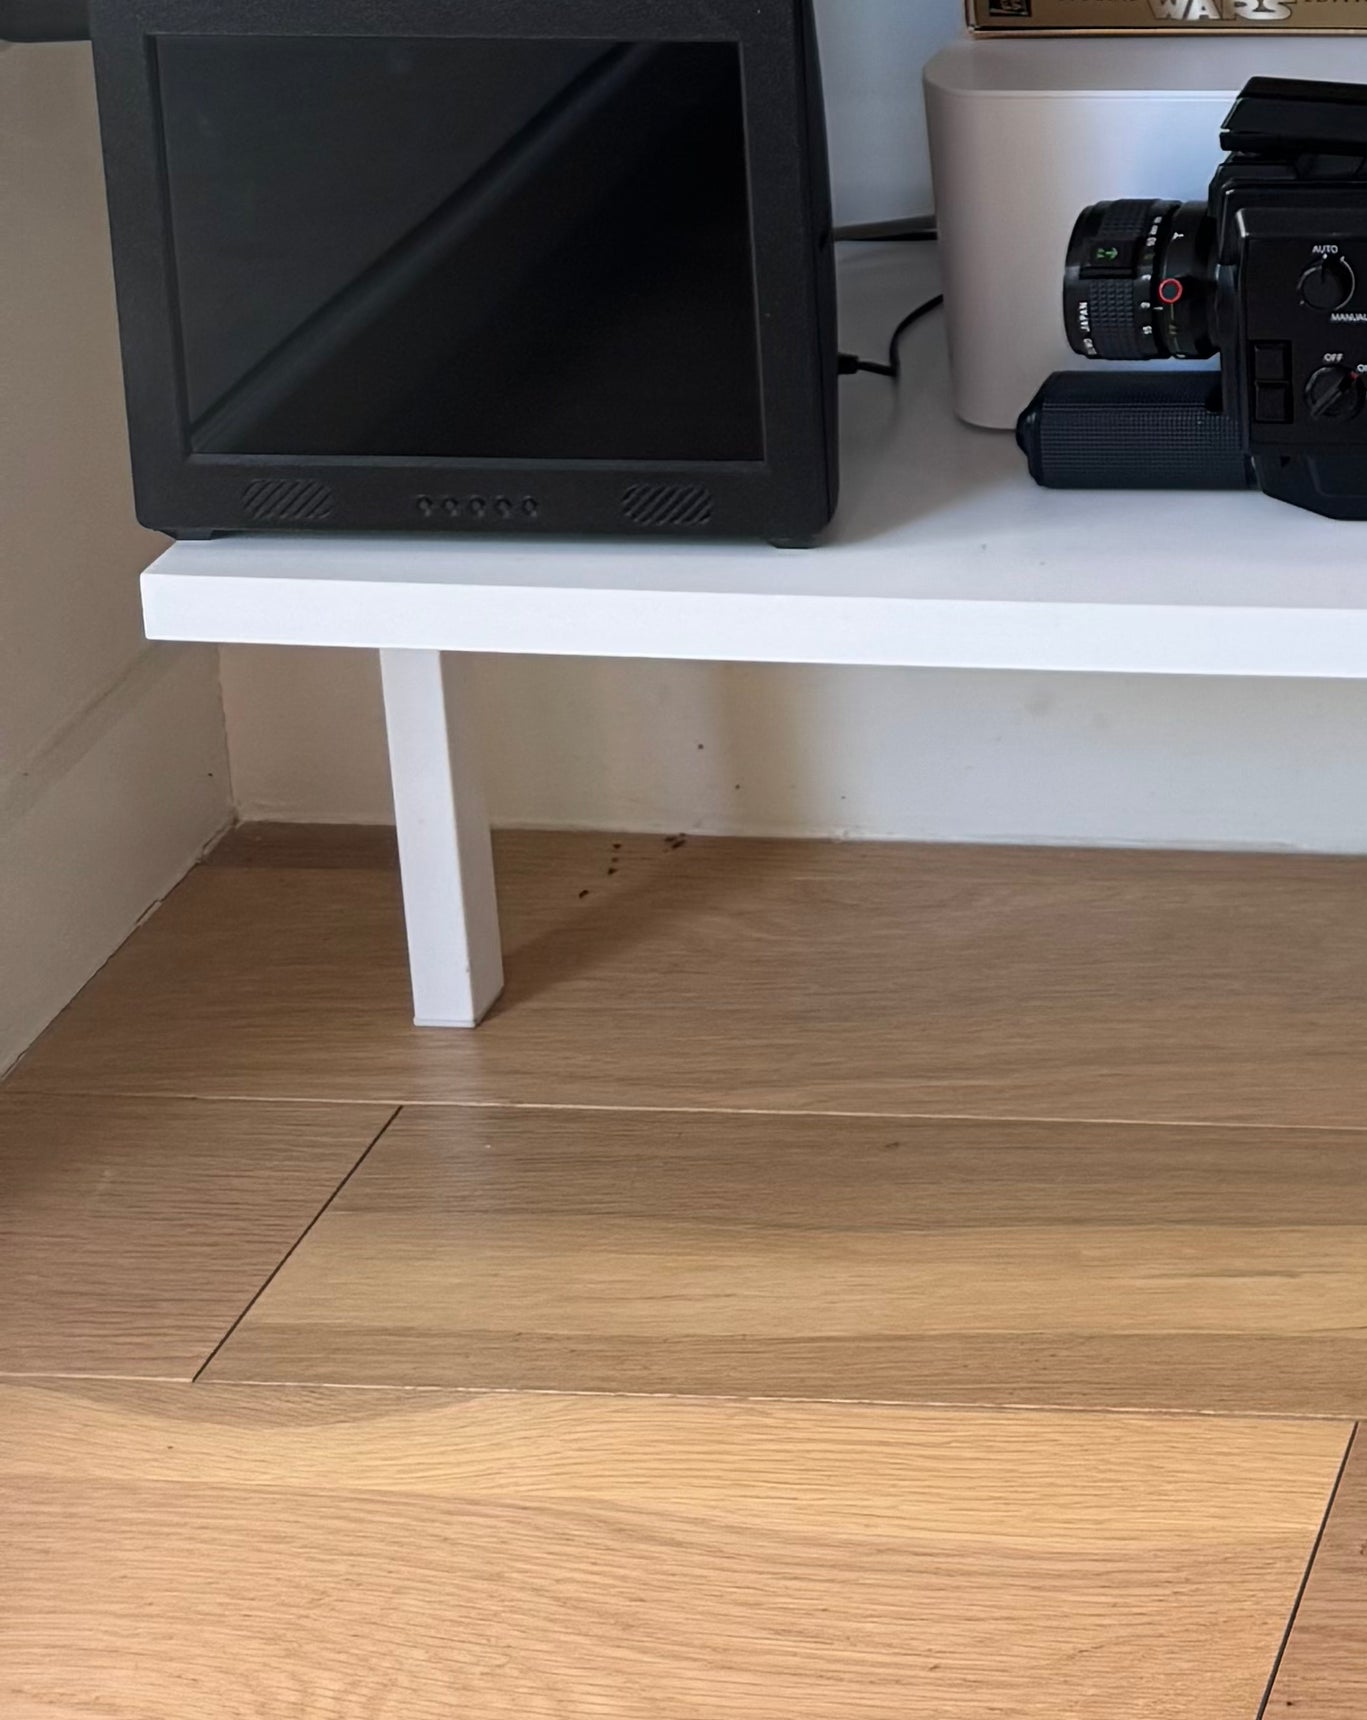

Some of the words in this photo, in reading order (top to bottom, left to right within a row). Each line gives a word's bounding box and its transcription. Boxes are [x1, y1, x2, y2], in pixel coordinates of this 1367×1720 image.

[1311, 244, 1339, 254] AUTO
[1078, 301, 1091, 333] JAPAN
[1323, 352, 1344, 363] OFF
